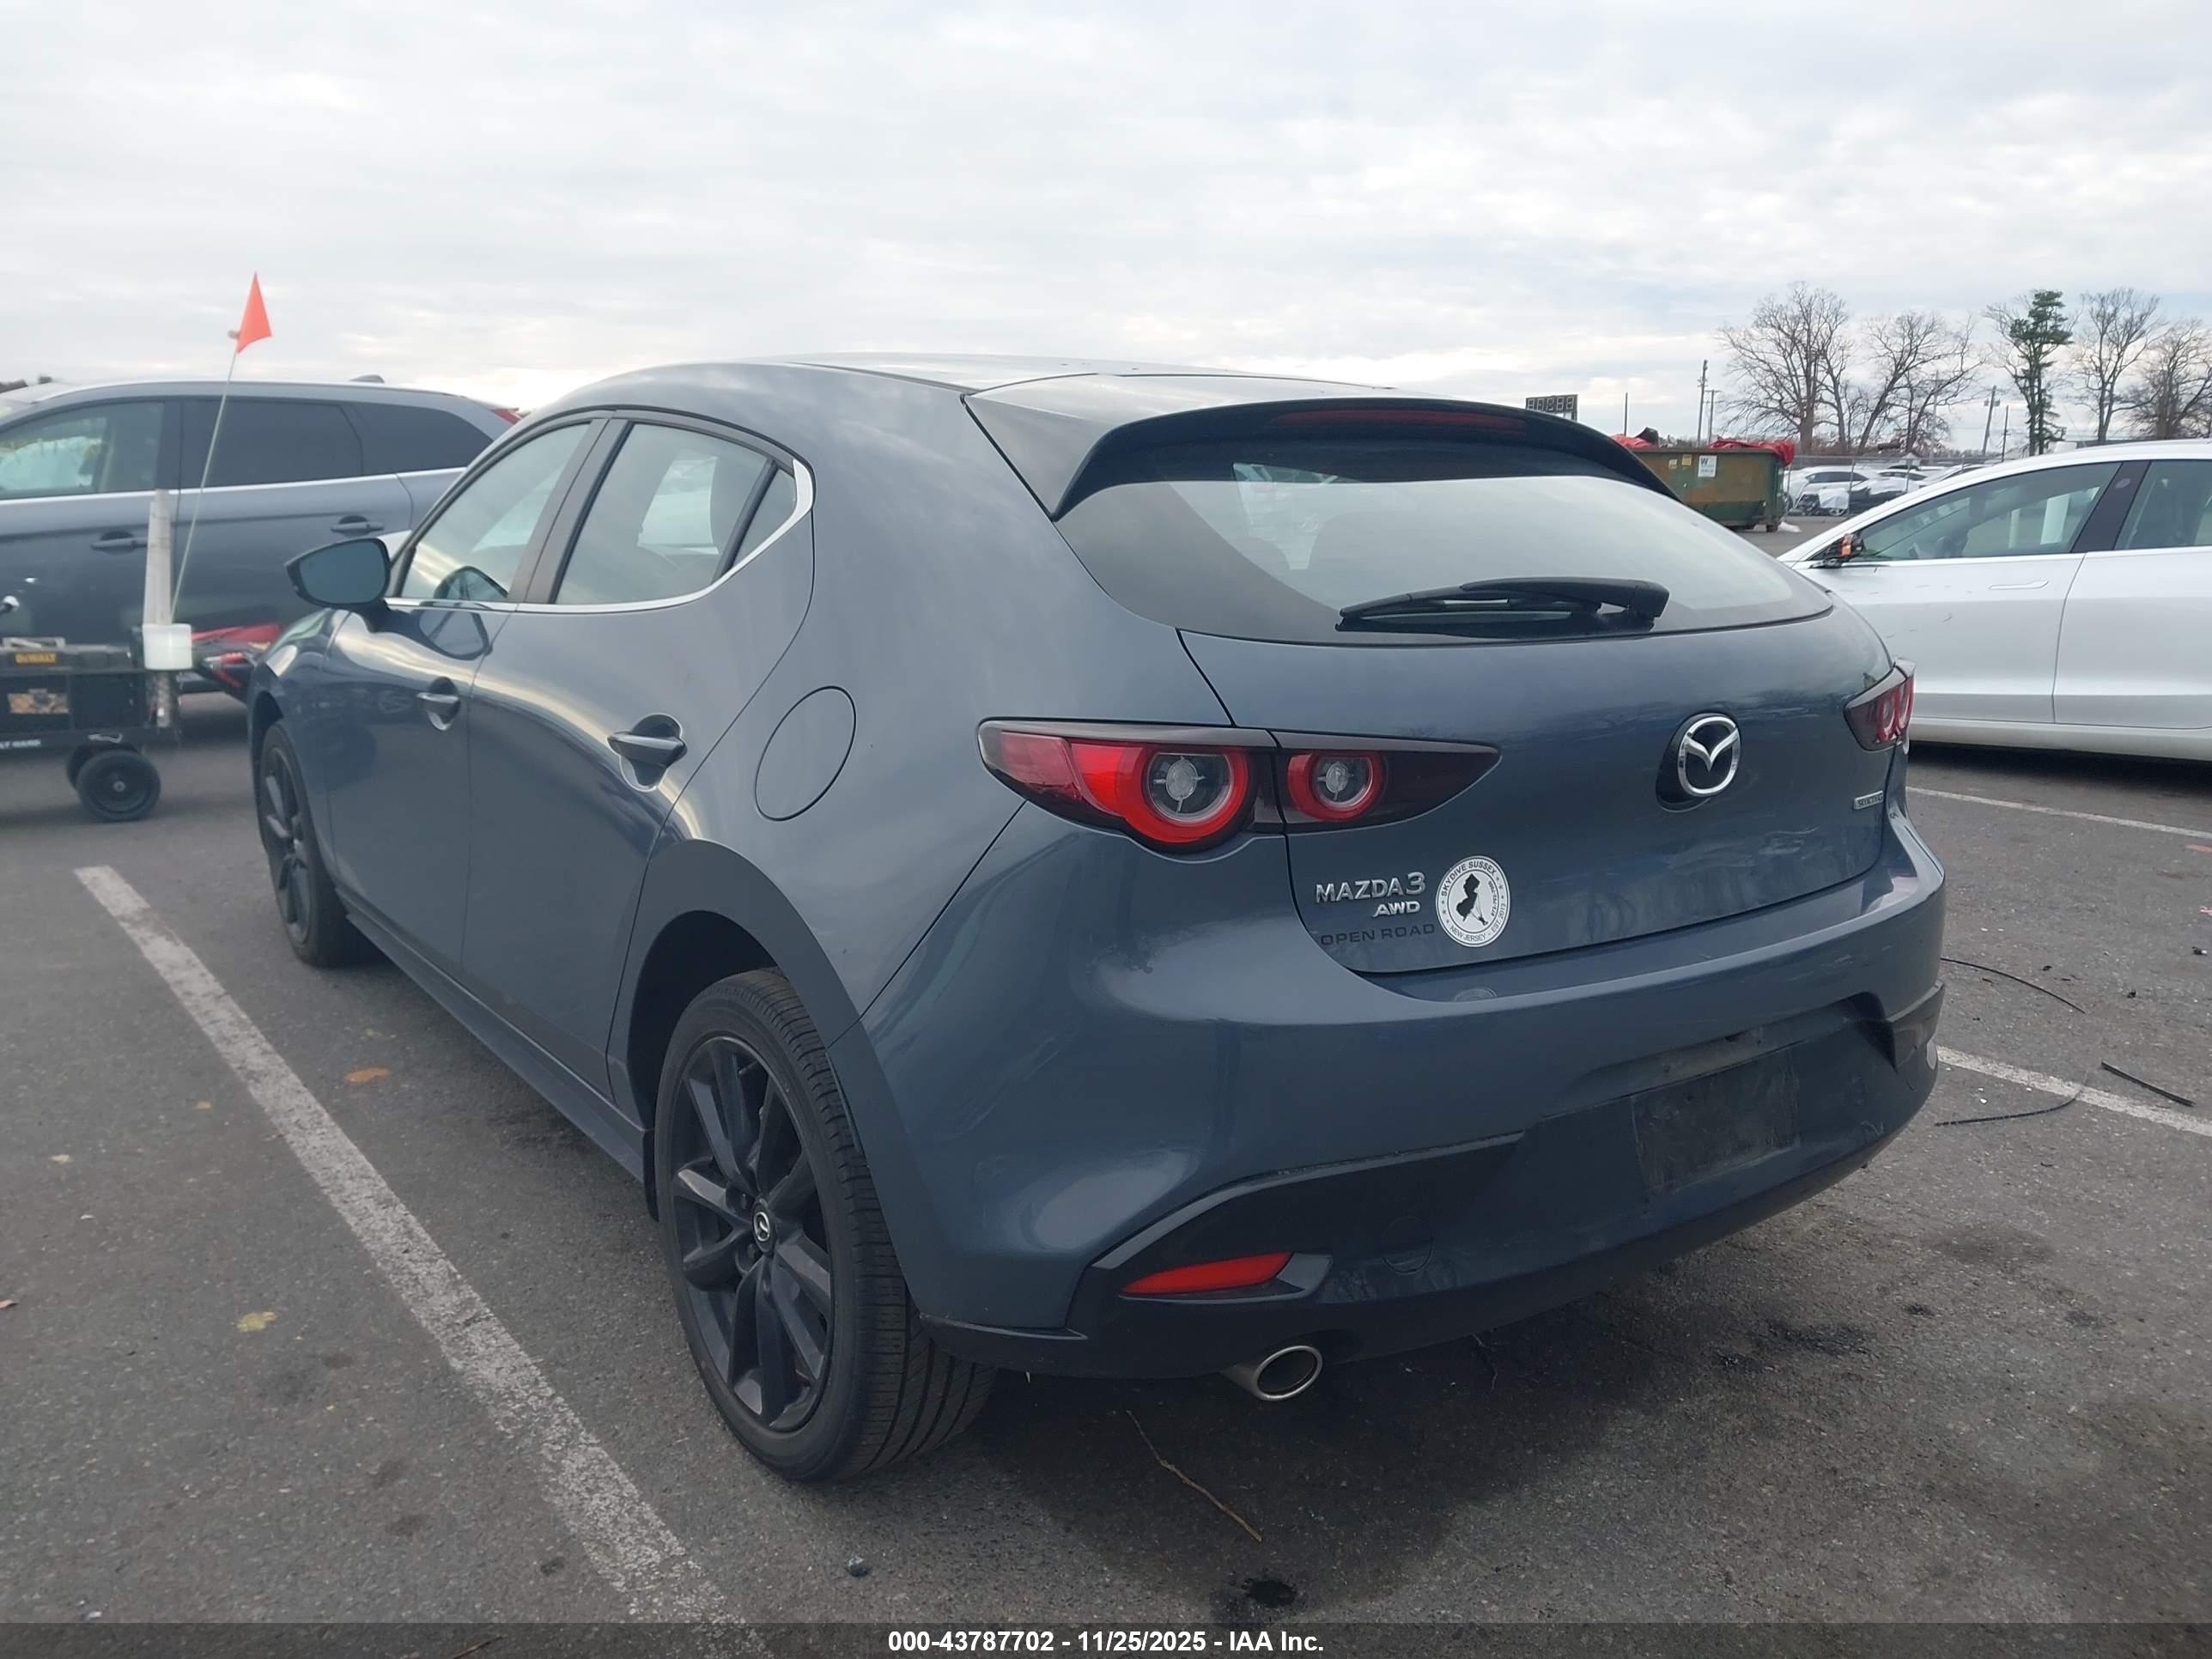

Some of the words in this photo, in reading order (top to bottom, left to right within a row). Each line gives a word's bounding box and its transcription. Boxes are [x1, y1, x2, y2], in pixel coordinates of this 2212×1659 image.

[1442, 864, 1467, 897] SKYDIVE
[1468, 860, 1497, 875] SUSSEX
[1372, 900, 1421, 918] AWD
[1321, 929, 1376, 945] OPEN
[1380, 923, 1436, 940] ROAD
[1449, 926, 1463, 939] NEW
[1463, 933, 1486, 942] JERSEY
